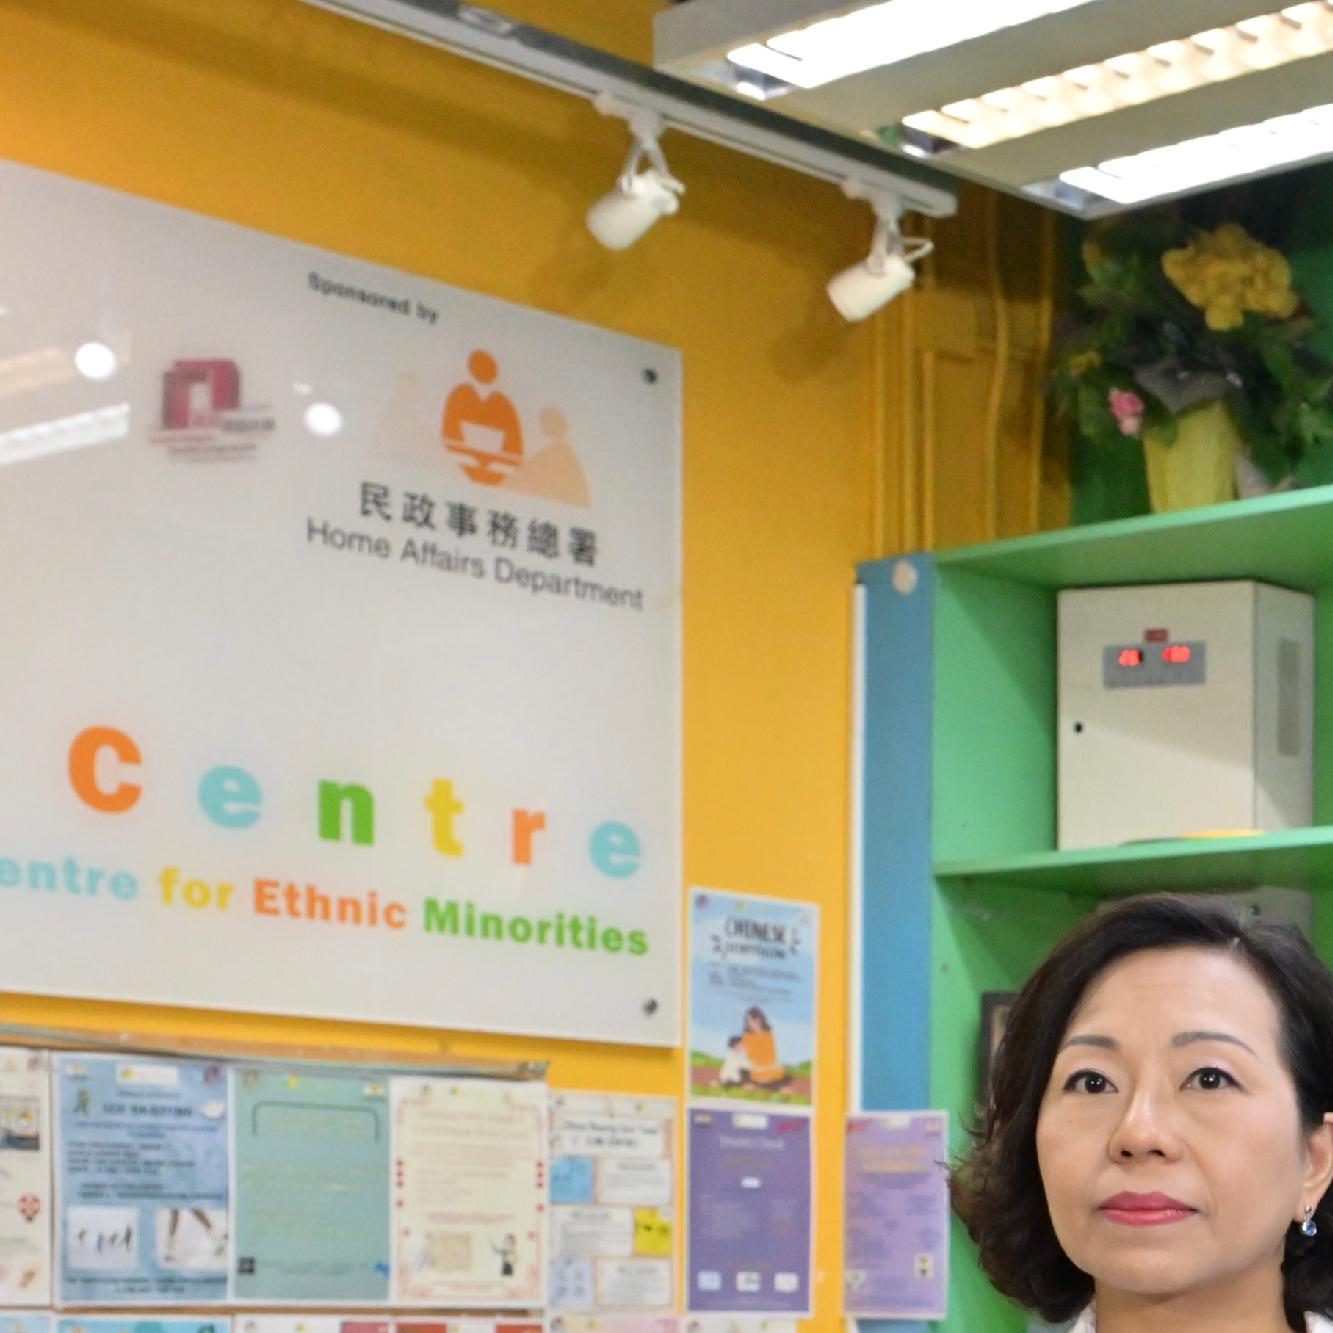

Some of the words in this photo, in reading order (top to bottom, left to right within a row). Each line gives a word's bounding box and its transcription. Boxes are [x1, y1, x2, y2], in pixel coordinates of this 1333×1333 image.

[308, 271, 411, 317] Sponsored
[416, 304, 438, 324] by
[306, 517, 391, 559] Home
[400, 537, 486, 579] Affairs
[494, 557, 644, 611] Department
[360, 480, 597, 567] 民政事務總署
[68, 724, 643, 881] Centre
[159, 866, 236, 911] for
[253, 878, 407, 930] Ethnic
[423, 898, 649, 957] Minorities
